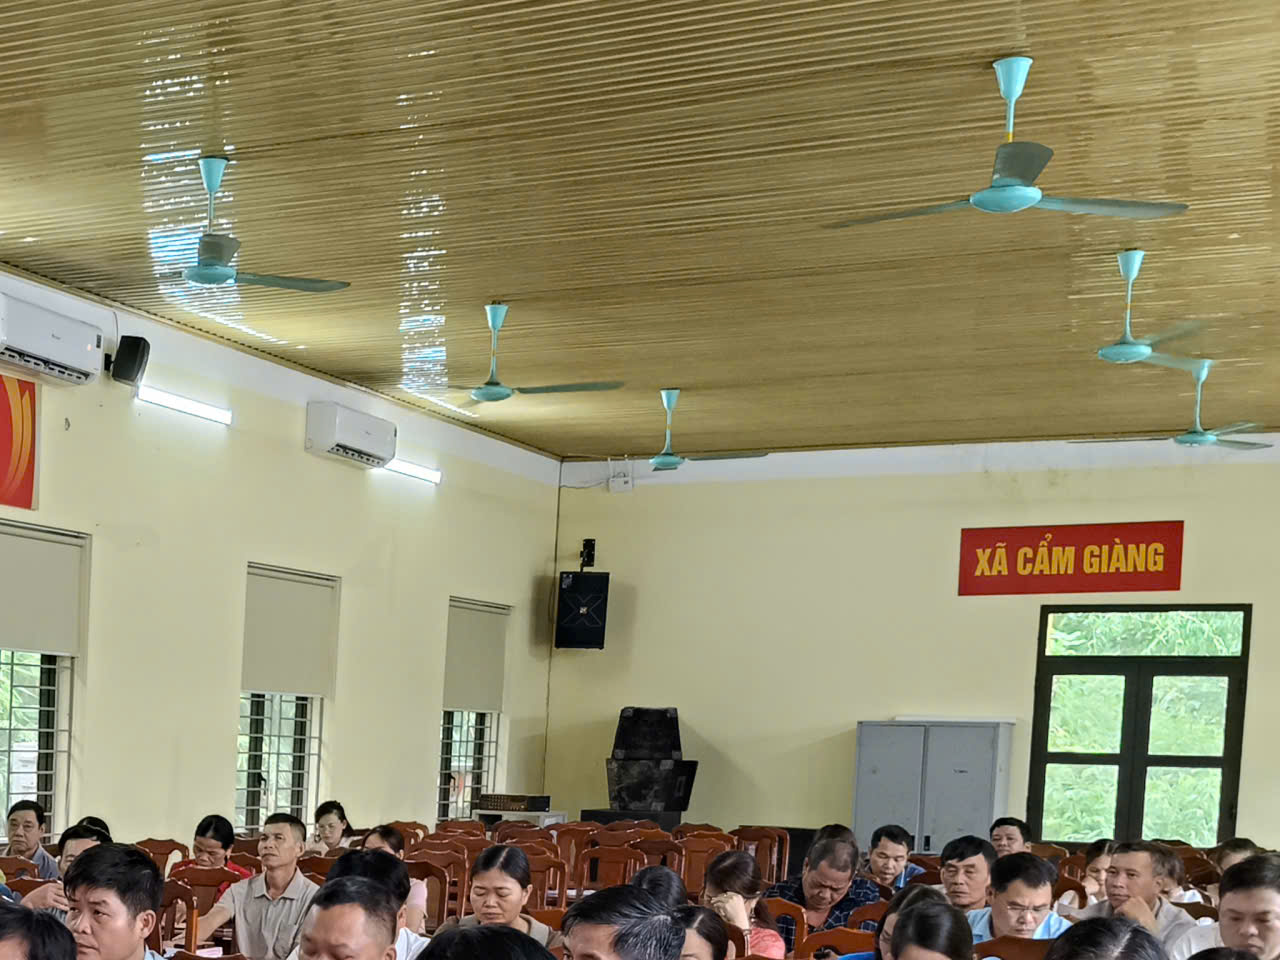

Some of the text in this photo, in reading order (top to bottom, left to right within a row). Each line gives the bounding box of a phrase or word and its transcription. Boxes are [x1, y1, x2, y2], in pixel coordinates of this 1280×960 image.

[974, 533, 1165, 577] XÃ CẨM GIÀNG
